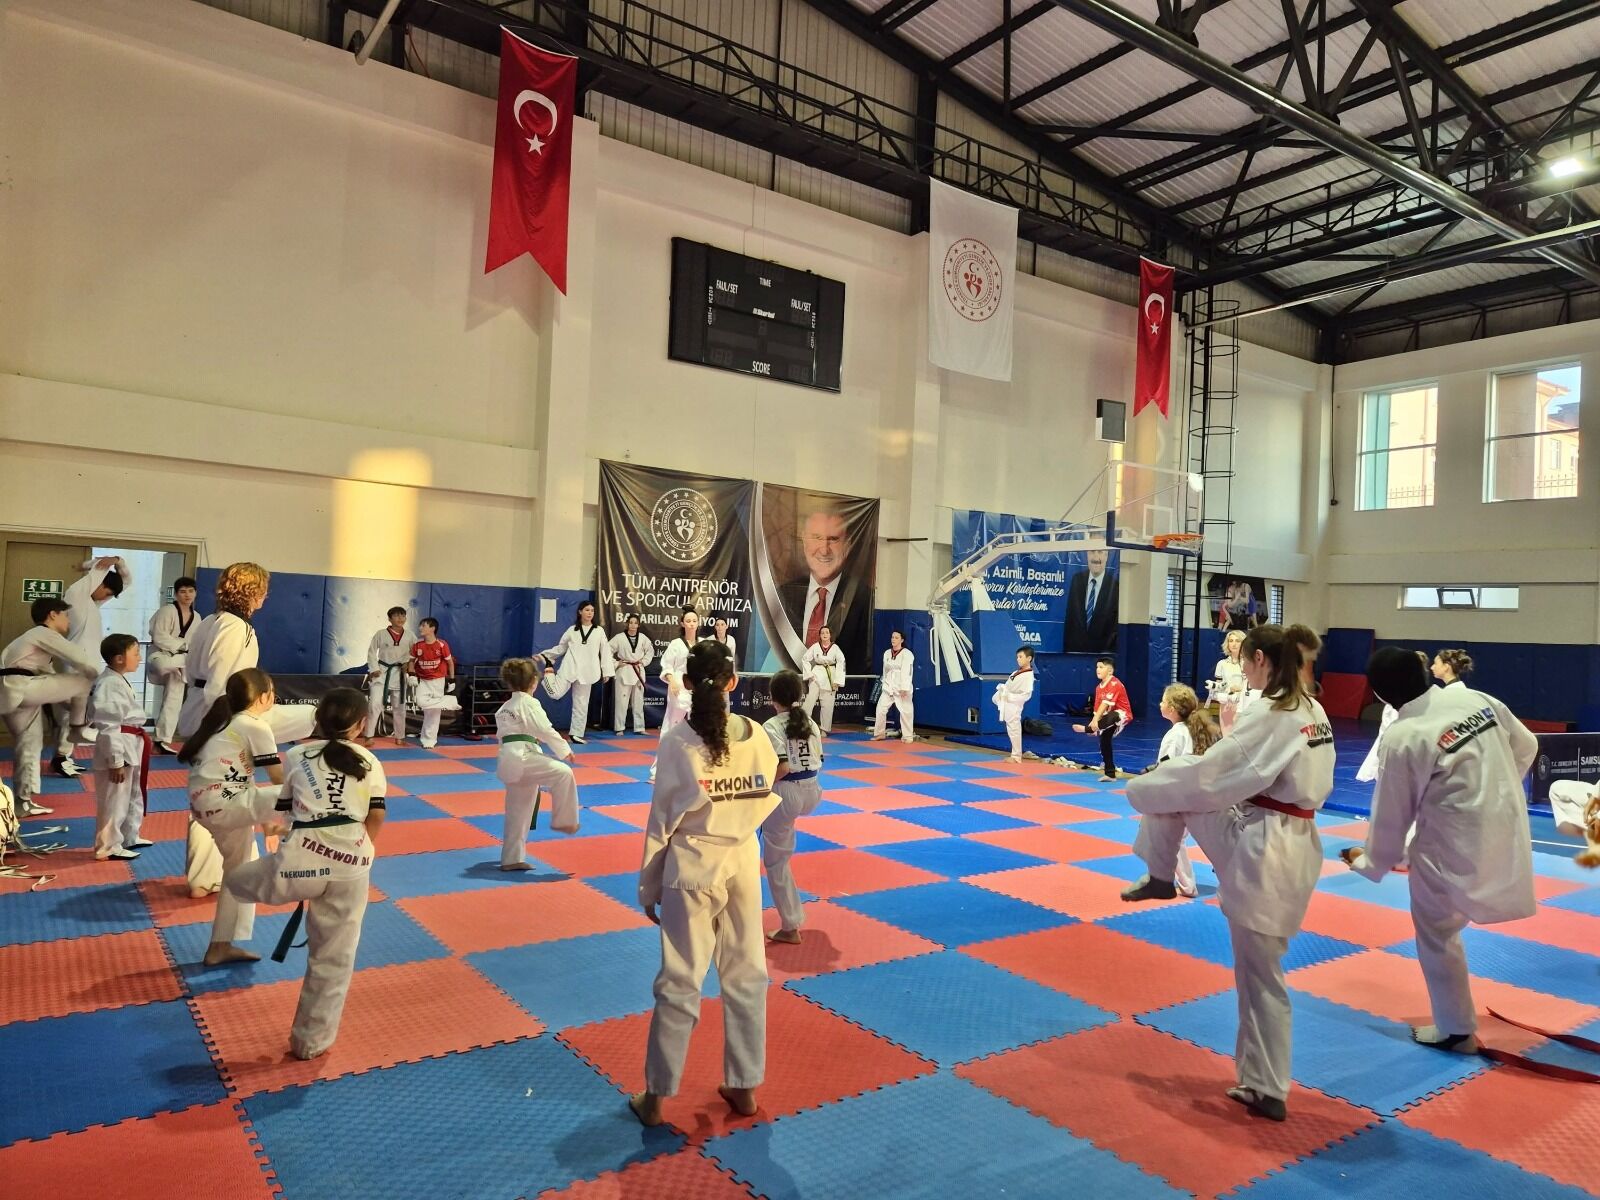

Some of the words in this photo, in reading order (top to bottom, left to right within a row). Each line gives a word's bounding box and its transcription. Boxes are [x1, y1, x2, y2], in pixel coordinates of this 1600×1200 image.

[752, 360, 771, 375] SCORE
[992, 566, 1024, 581] Azimli,
[622, 572, 656, 590] TÜM
[660, 577, 739, 596] ANTRENÖR
[985, 582, 1005, 593] orcu
[602, 590, 622, 605] VE
[615, 612, 679, 625] BAARILAR
[1020, 632, 1041, 641] RACA
[1580, 755, 1600, 765] SAMS
[326, 772, 346, 811] 권도
[301, 836, 359, 865] TAEKWON
[280, 870, 316, 879] TAEKWON
[319, 867, 331, 876] DO
